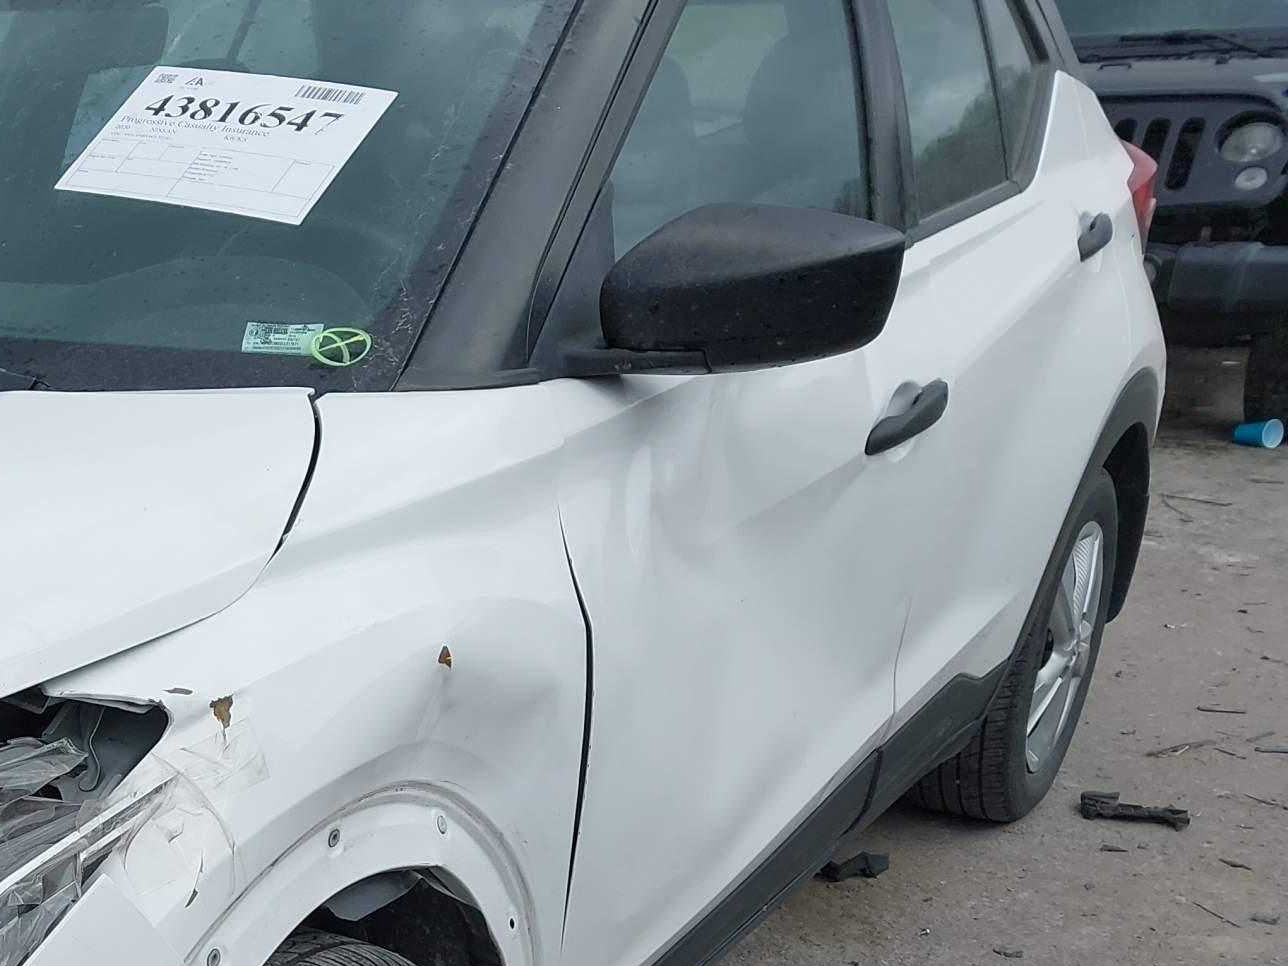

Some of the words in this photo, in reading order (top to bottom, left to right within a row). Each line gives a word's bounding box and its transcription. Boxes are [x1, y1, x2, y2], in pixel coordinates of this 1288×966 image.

[120, 114, 176, 128] Progressive
[177, 120, 218, 132] Casualty
[221, 125, 271, 137] Insurance
[144, 94, 344, 136] 43816547
